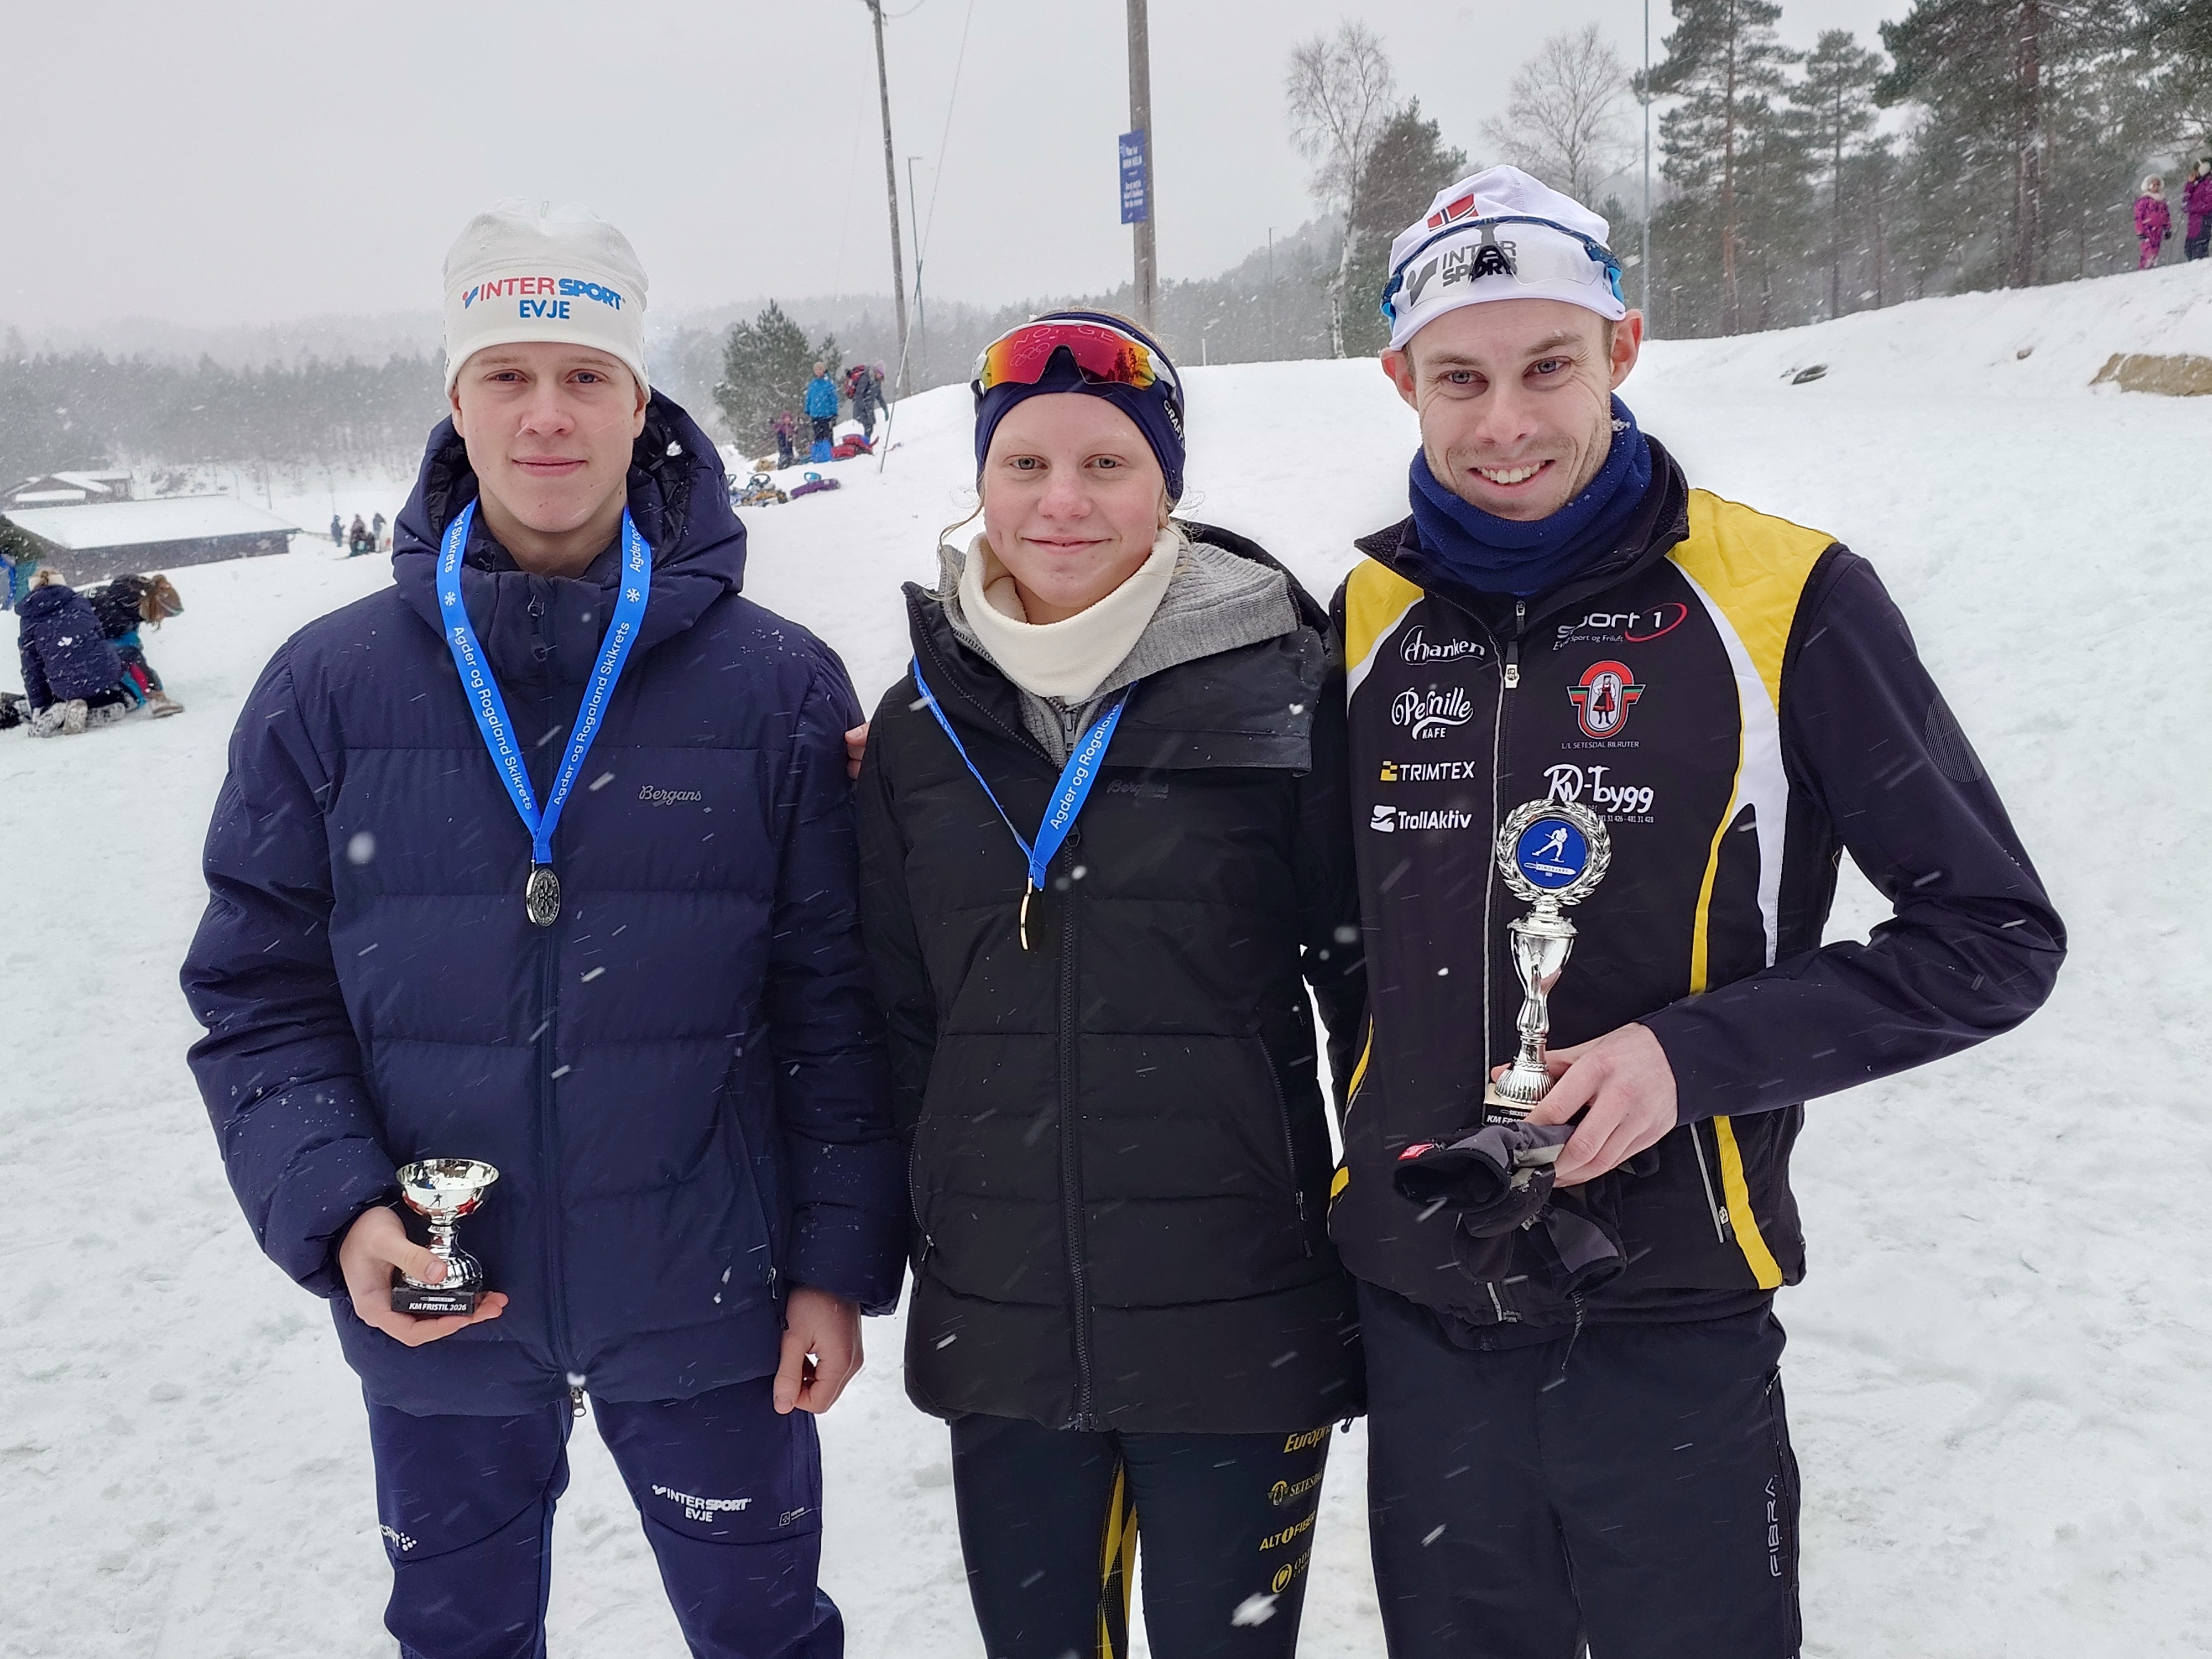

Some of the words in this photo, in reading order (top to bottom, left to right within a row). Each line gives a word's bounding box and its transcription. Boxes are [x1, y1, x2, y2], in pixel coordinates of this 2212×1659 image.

[1443, 241, 1516, 269] INTR
[520, 300, 570, 319] EVJE
[1014, 327, 1114, 349] NOGE
[1164, 400, 1183, 440] CRAFT
[445, 526, 462, 573] Skikrets
[629, 540, 644, 572] Agder
[1653, 612, 1662, 628] 1
[601, 622, 630, 674] Skikrets
[453, 627, 477, 666] Agder
[471, 668, 484, 688] og
[478, 688, 513, 755] Rogaland
[505, 757, 533, 810] Skikrets
[577, 677, 608, 742] Rogaland
[1391, 686, 1474, 726] Pernille
[1422, 727, 1447, 739] KAFE
[572, 744, 584, 763] og
[1400, 761, 1475, 781] TRIMTEX
[553, 765, 574, 806] Agder
[639, 785, 702, 806] Bergans
[1050, 786, 1078, 830] Agder
[1071, 766, 1089, 787] og
[1398, 810, 1472, 830] TrollAktiv
[1486, 1115, 1502, 1124] KM
[685, 1507, 713, 1522] EVJE
